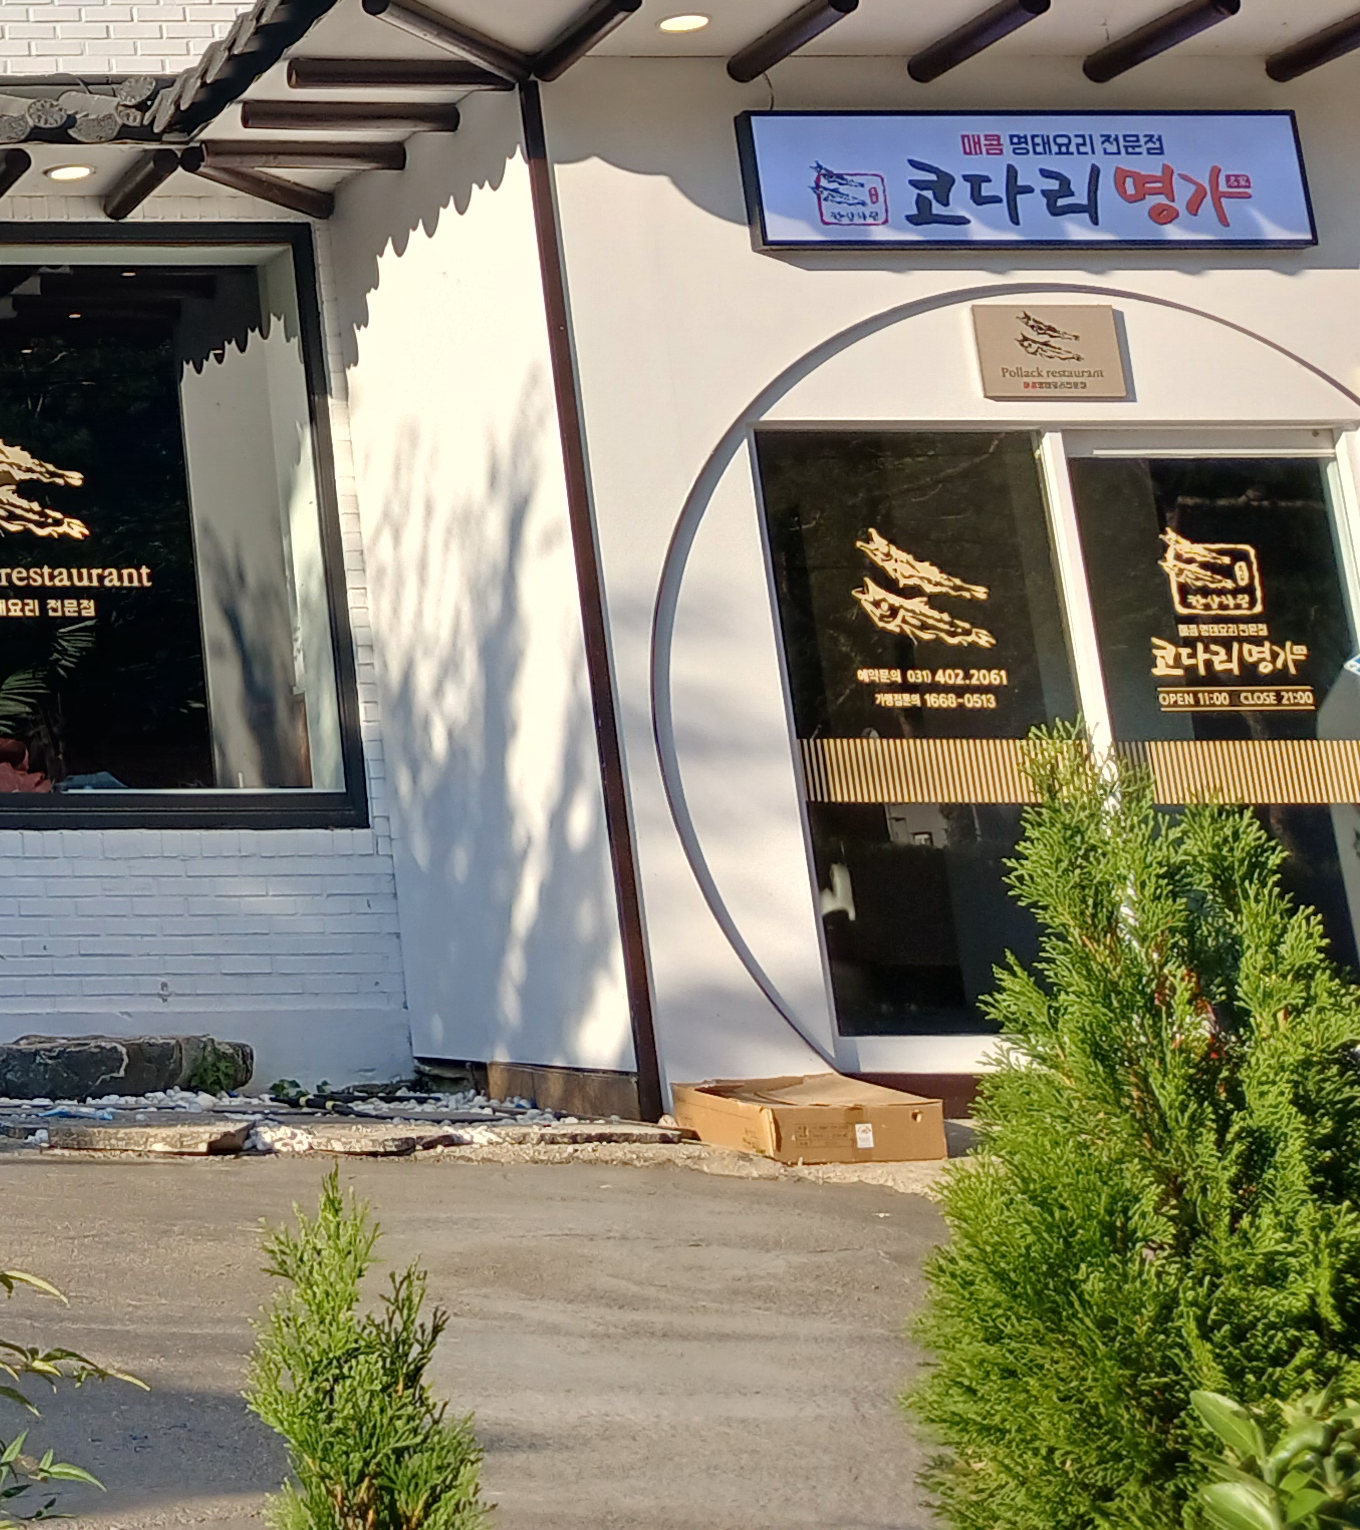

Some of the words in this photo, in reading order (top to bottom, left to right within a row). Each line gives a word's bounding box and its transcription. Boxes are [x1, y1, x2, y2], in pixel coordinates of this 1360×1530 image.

[1008, 133, 1096, 156] 명태요리
[1099, 133, 1166, 156] 전문점
[1000, 366, 1044, 378] Pollack
[1045, 368, 1105, 378] restaurant
[934, 669, 1009, 686] 402.2061
[923, 693, 997, 708] 1668-0513
[1158, 693, 1195, 705] OPEN
[1197, 693, 1230, 705] 11:00
[1239, 692, 1278, 705] CLOSE
[1280, 691, 1314, 704] 21:00
